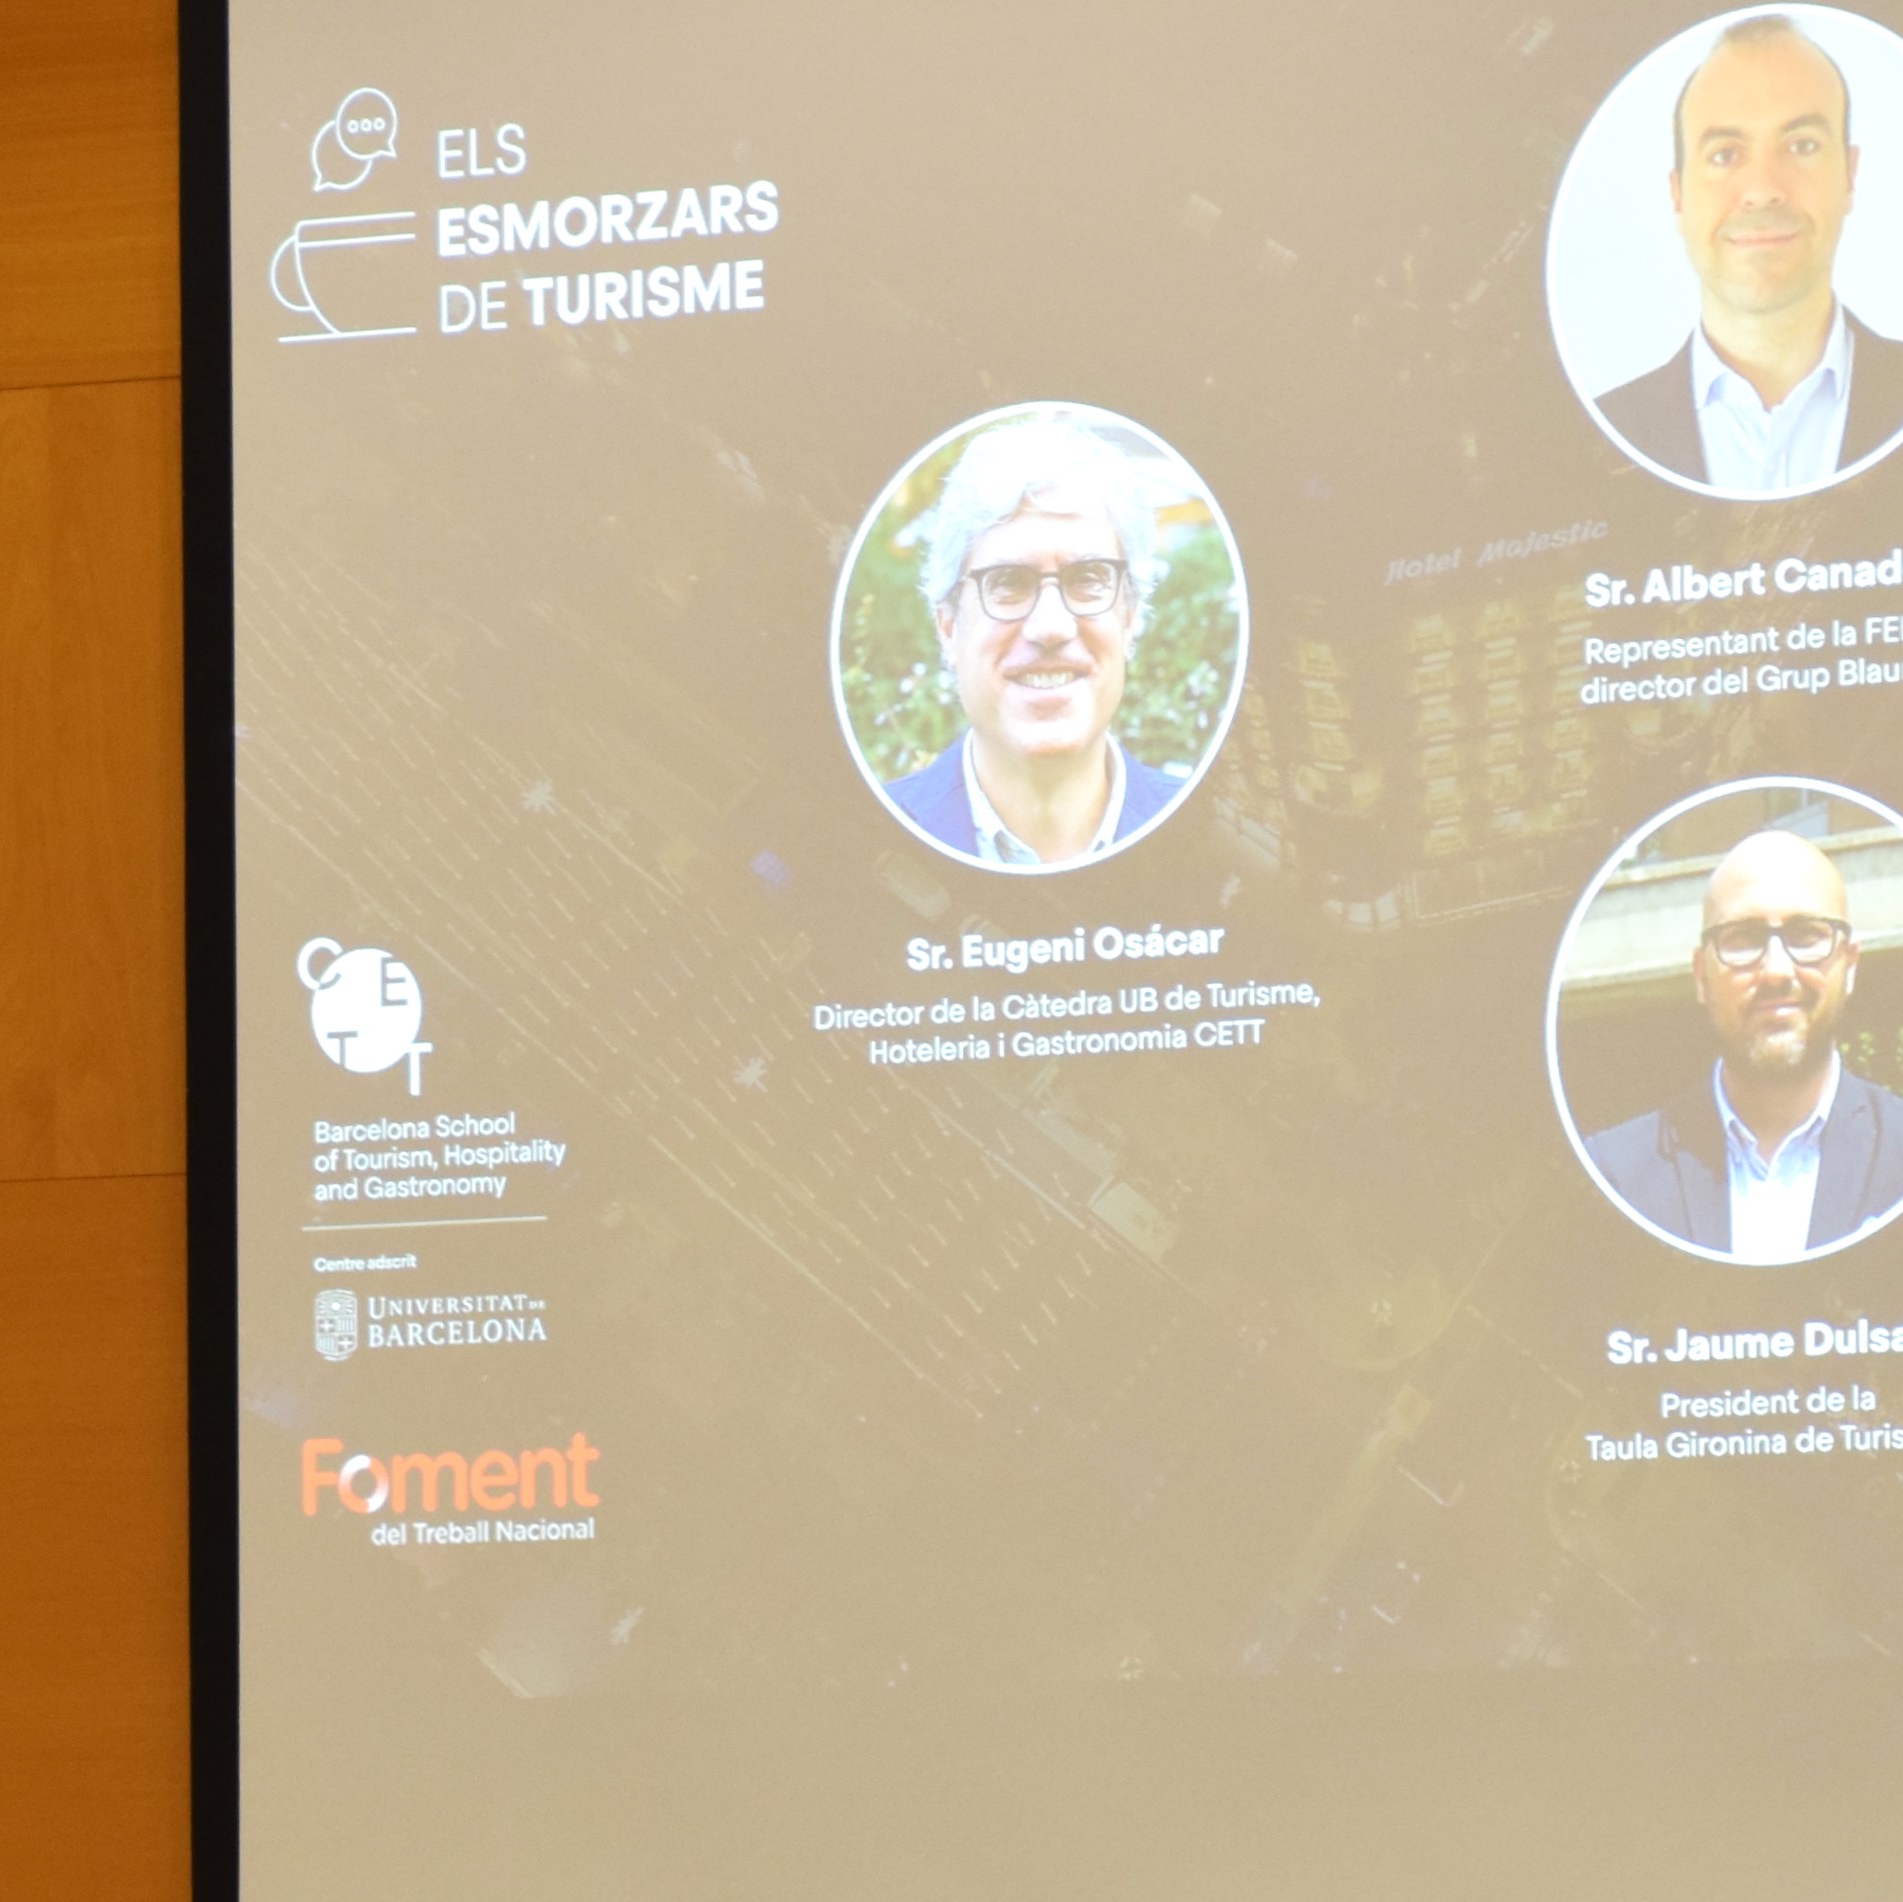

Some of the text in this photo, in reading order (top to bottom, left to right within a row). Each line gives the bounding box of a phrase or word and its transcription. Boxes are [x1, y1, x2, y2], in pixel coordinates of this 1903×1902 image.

[437, 122, 528, 181] ELS
[436, 179, 780, 259] ESMORZARS
[439, 259, 765, 336] DE TURISME
[1584, 572, 1636, 609] Sr.
[1641, 562, 1767, 604] Albert
[1584, 626, 1780, 669] Representant
[1785, 622, 1827, 651] de
[1831, 619, 1858, 647] la
[1579, 673, 1698, 705] director
[1700, 665, 1749, 697] del
[1754, 663, 1831, 695] Grup
[906, 923, 1226, 975] Sr. Eugeni Osácar
[813, 979, 1322, 1031] Director de la Càtedra UB de Turisme,
[869, 1017, 1266, 1065] Hoteleria i Gastronomia CETT
[314, 1111, 516, 1144] Barcelona School
[313, 1138, 567, 1173] of Tourism, Hospitality
[313, 1175, 507, 1203] and Gastronomy
[312, 1253, 418, 1273] Centre adscrit
[367, 1317, 547, 1348] BARCELONA
[1606, 1327, 1659, 1365] Sr.
[1663, 1327, 1796, 1363] Jaume
[1660, 1383, 1877, 1419] President de la
[1585, 1432, 1659, 1461] Taula
[1664, 1427, 1788, 1459] Gironina
[1793, 1424, 1835, 1454] de
[302, 1432, 600, 1516] Foment
[370, 1516, 595, 1546] del Treball Nacional
